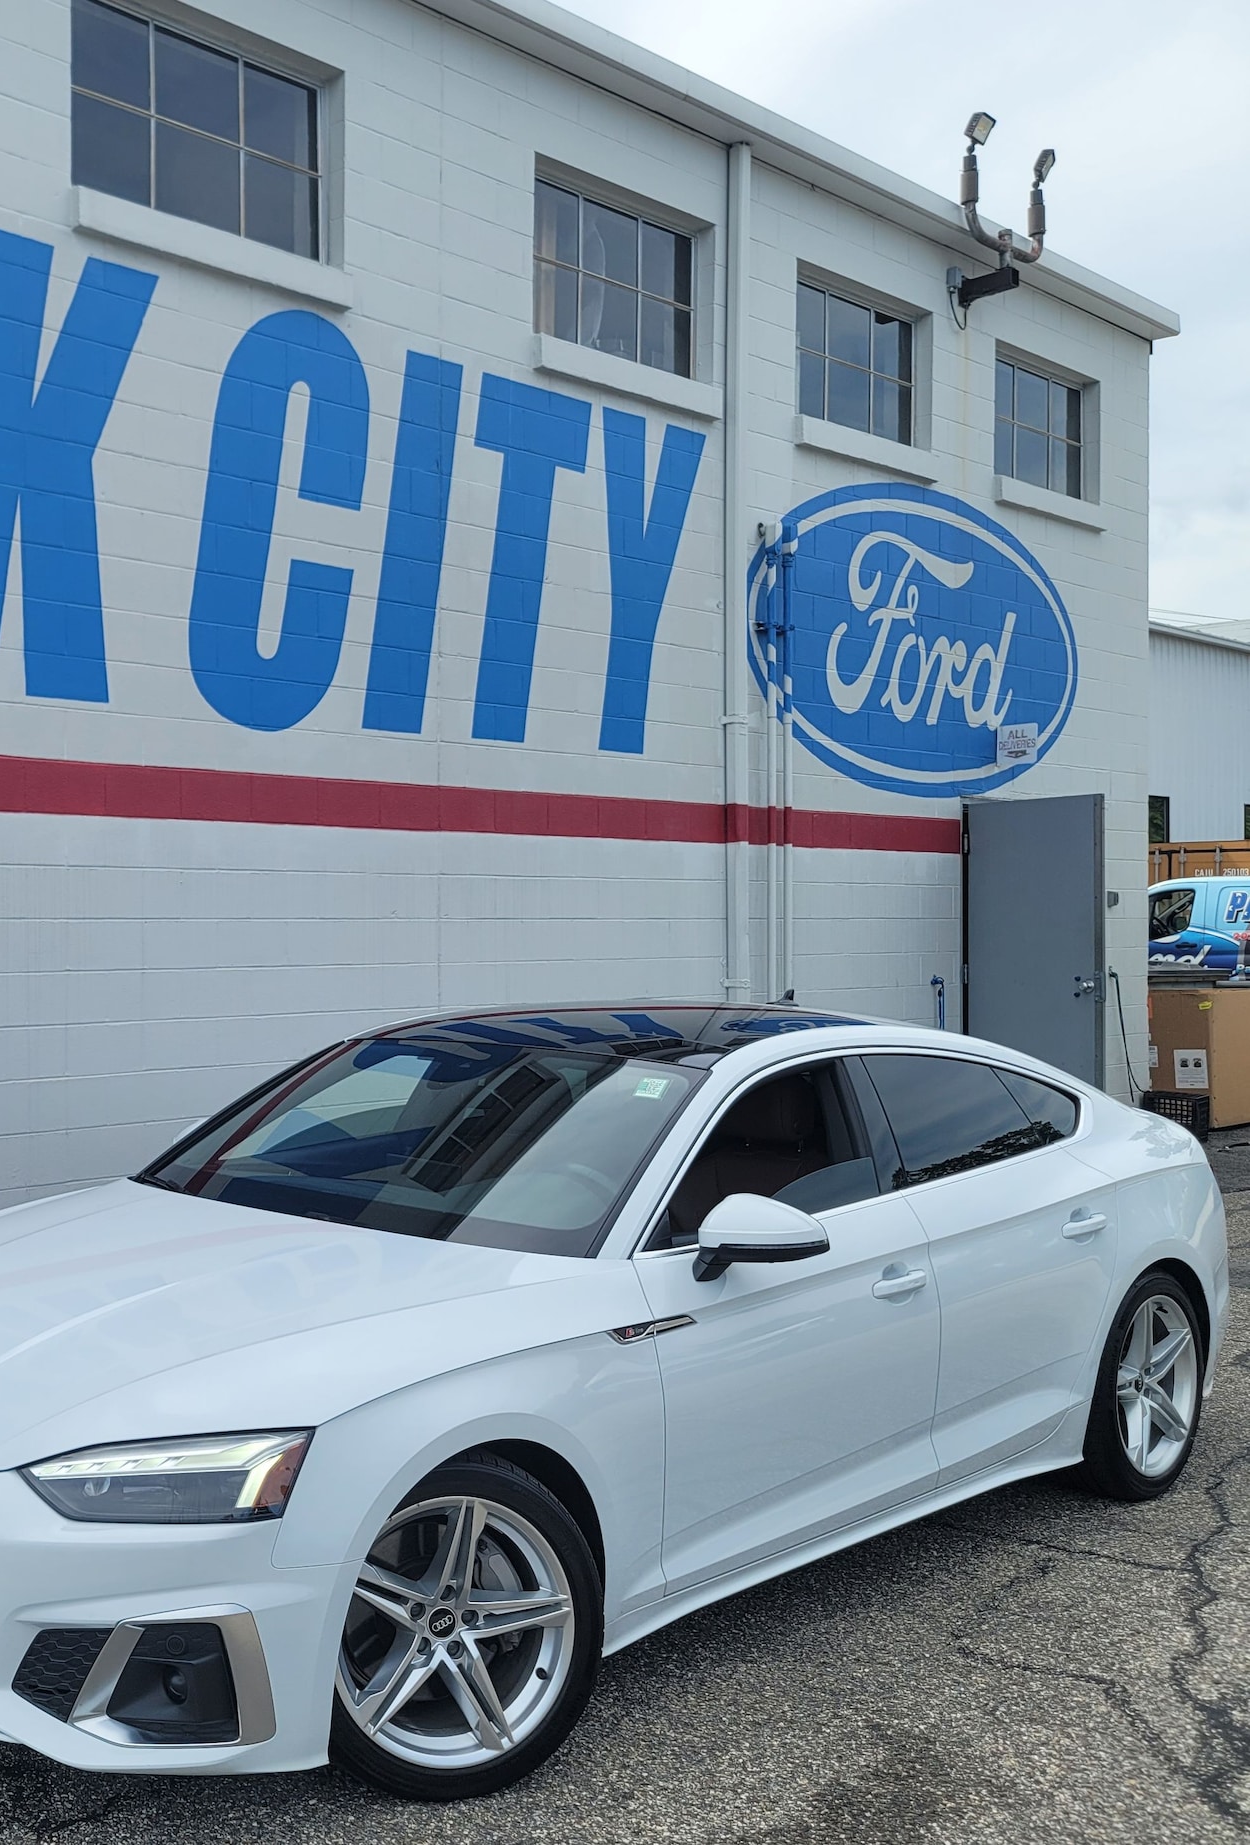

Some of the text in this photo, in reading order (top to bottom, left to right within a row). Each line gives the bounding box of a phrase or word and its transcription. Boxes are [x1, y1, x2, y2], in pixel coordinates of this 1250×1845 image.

[188, 308, 707, 754] CITY
[826, 530, 1017, 732] Ford
[998, 737, 1036, 751] DELIVERIES
[1007, 729, 1028, 740] ALL
